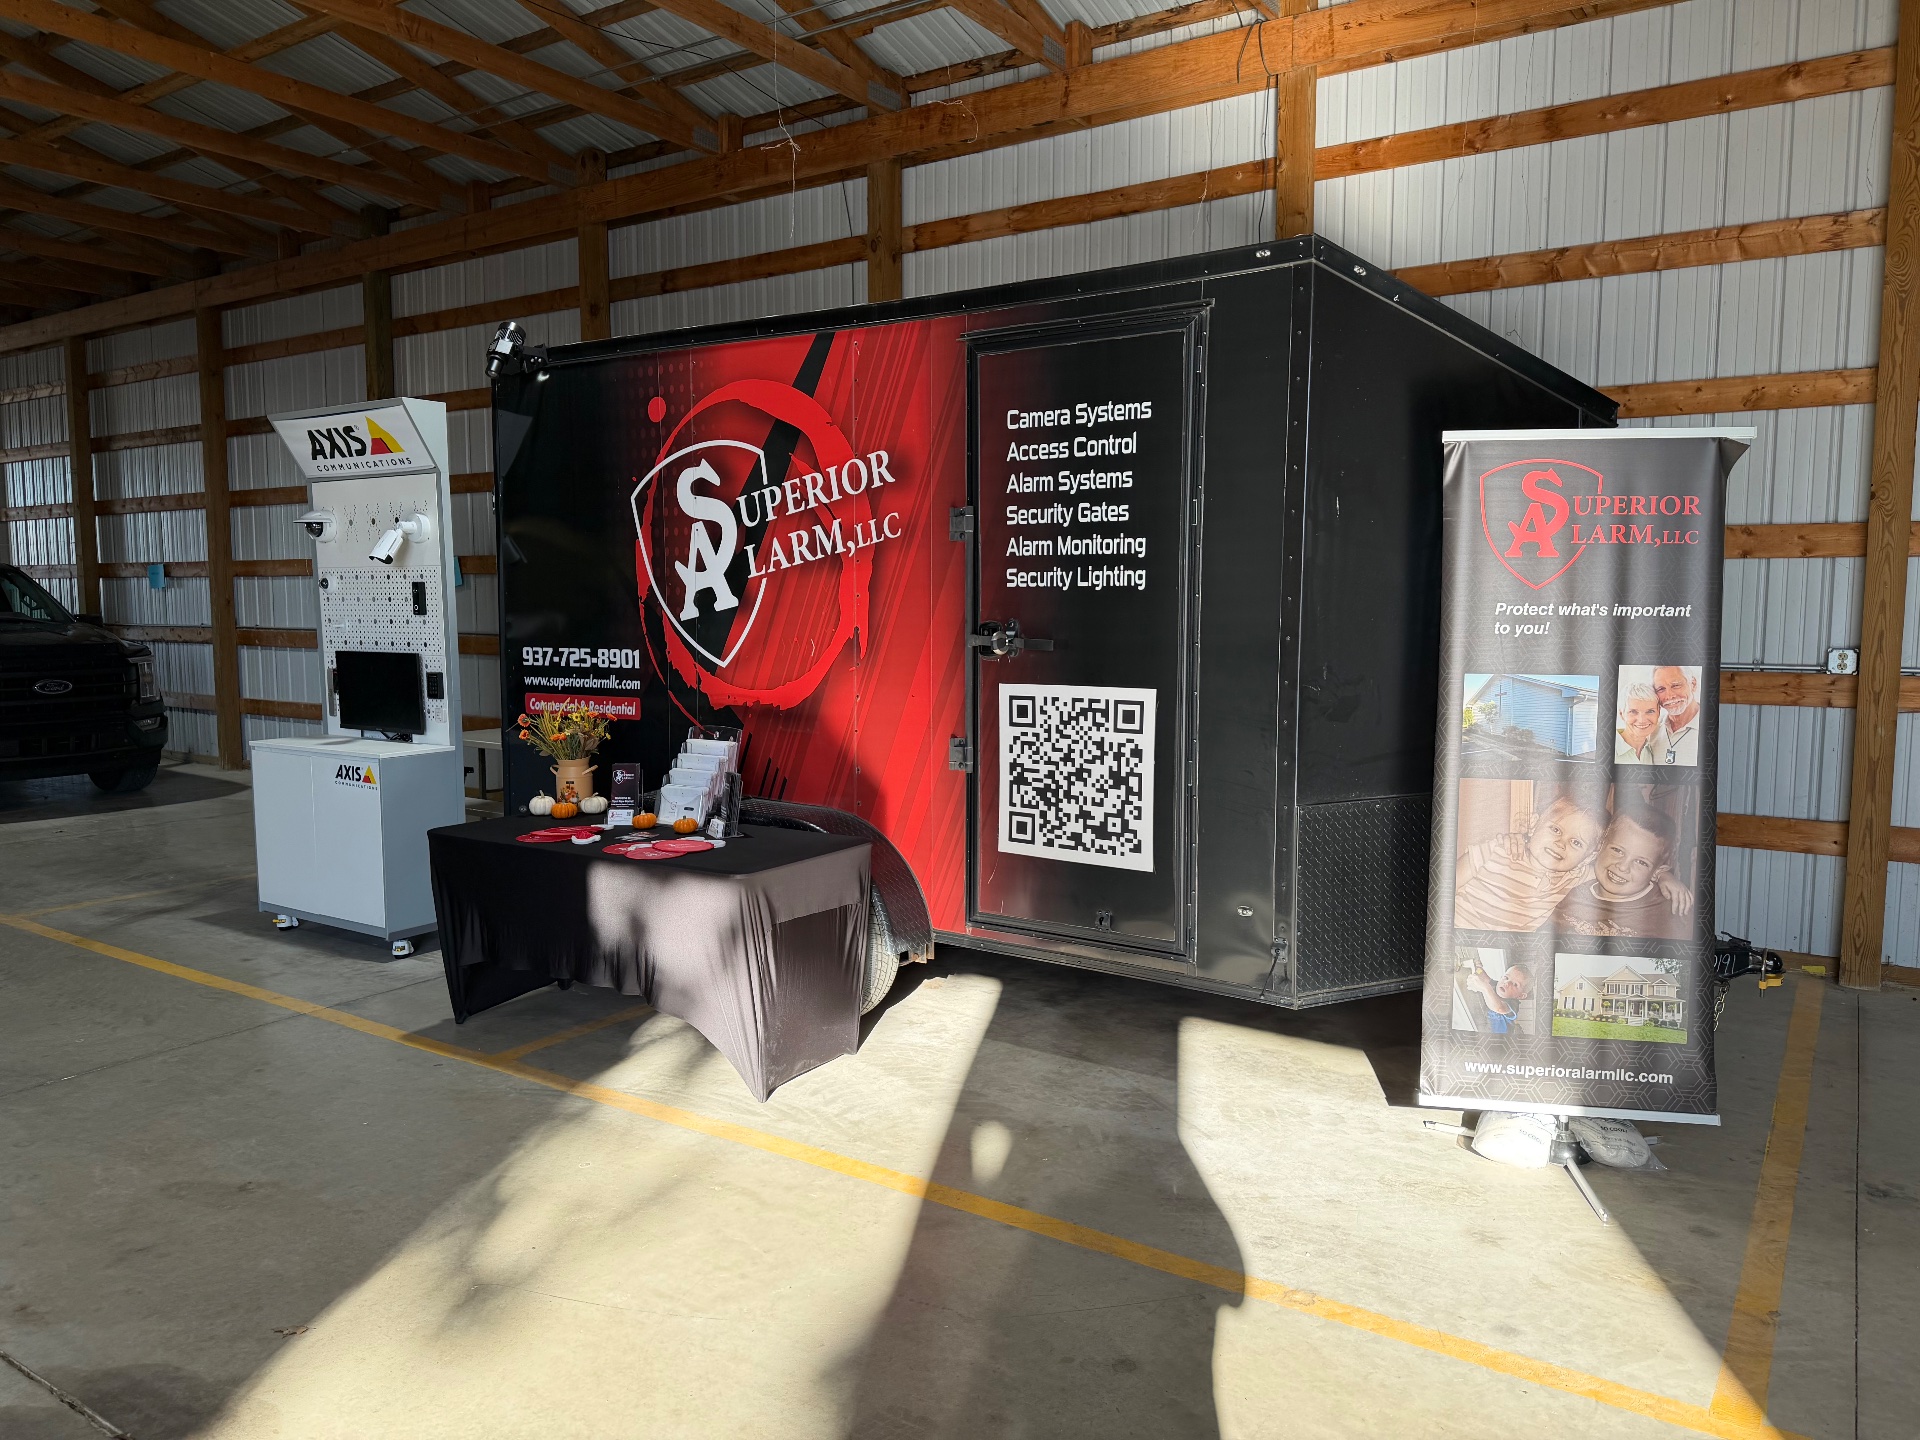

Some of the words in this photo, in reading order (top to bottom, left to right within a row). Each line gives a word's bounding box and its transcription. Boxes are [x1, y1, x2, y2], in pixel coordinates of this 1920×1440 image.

[1007, 409, 1070, 429] Camera
[1075, 401, 1152, 427] Systems
[1006, 442, 1069, 461] Access
[1073, 431, 1137, 457] Control
[317, 457, 412, 472] COMMUNICATIONS
[1006, 472, 1053, 493] Alarm
[1058, 469, 1133, 494] Systems
[1006, 503, 1073, 527] Security
[1078, 502, 1129, 522] Gates
[1006, 536, 1052, 556] Alarm
[1058, 533, 1146, 557] Monitoring
[1006, 567, 1073, 590] Security
[1077, 565, 1146, 590] Lighting
[1495, 602, 1554, 616] Protect
[1558, 602, 1609, 616] what's
[1612, 603, 1692, 619] important
[1494, 621, 1510, 635] to
[1513, 621, 1550, 637] you!
[522, 647, 640, 669] 937-725-8901
[524, 674, 640, 690] www.superioralarmllc.com
[589, 701, 636, 716] Residential
[335, 764, 362, 782] AXIS
[335, 780, 378, 791] COMMUNICATIONS
[1464, 1062, 1674, 1084] www.superioralarmllc.com
